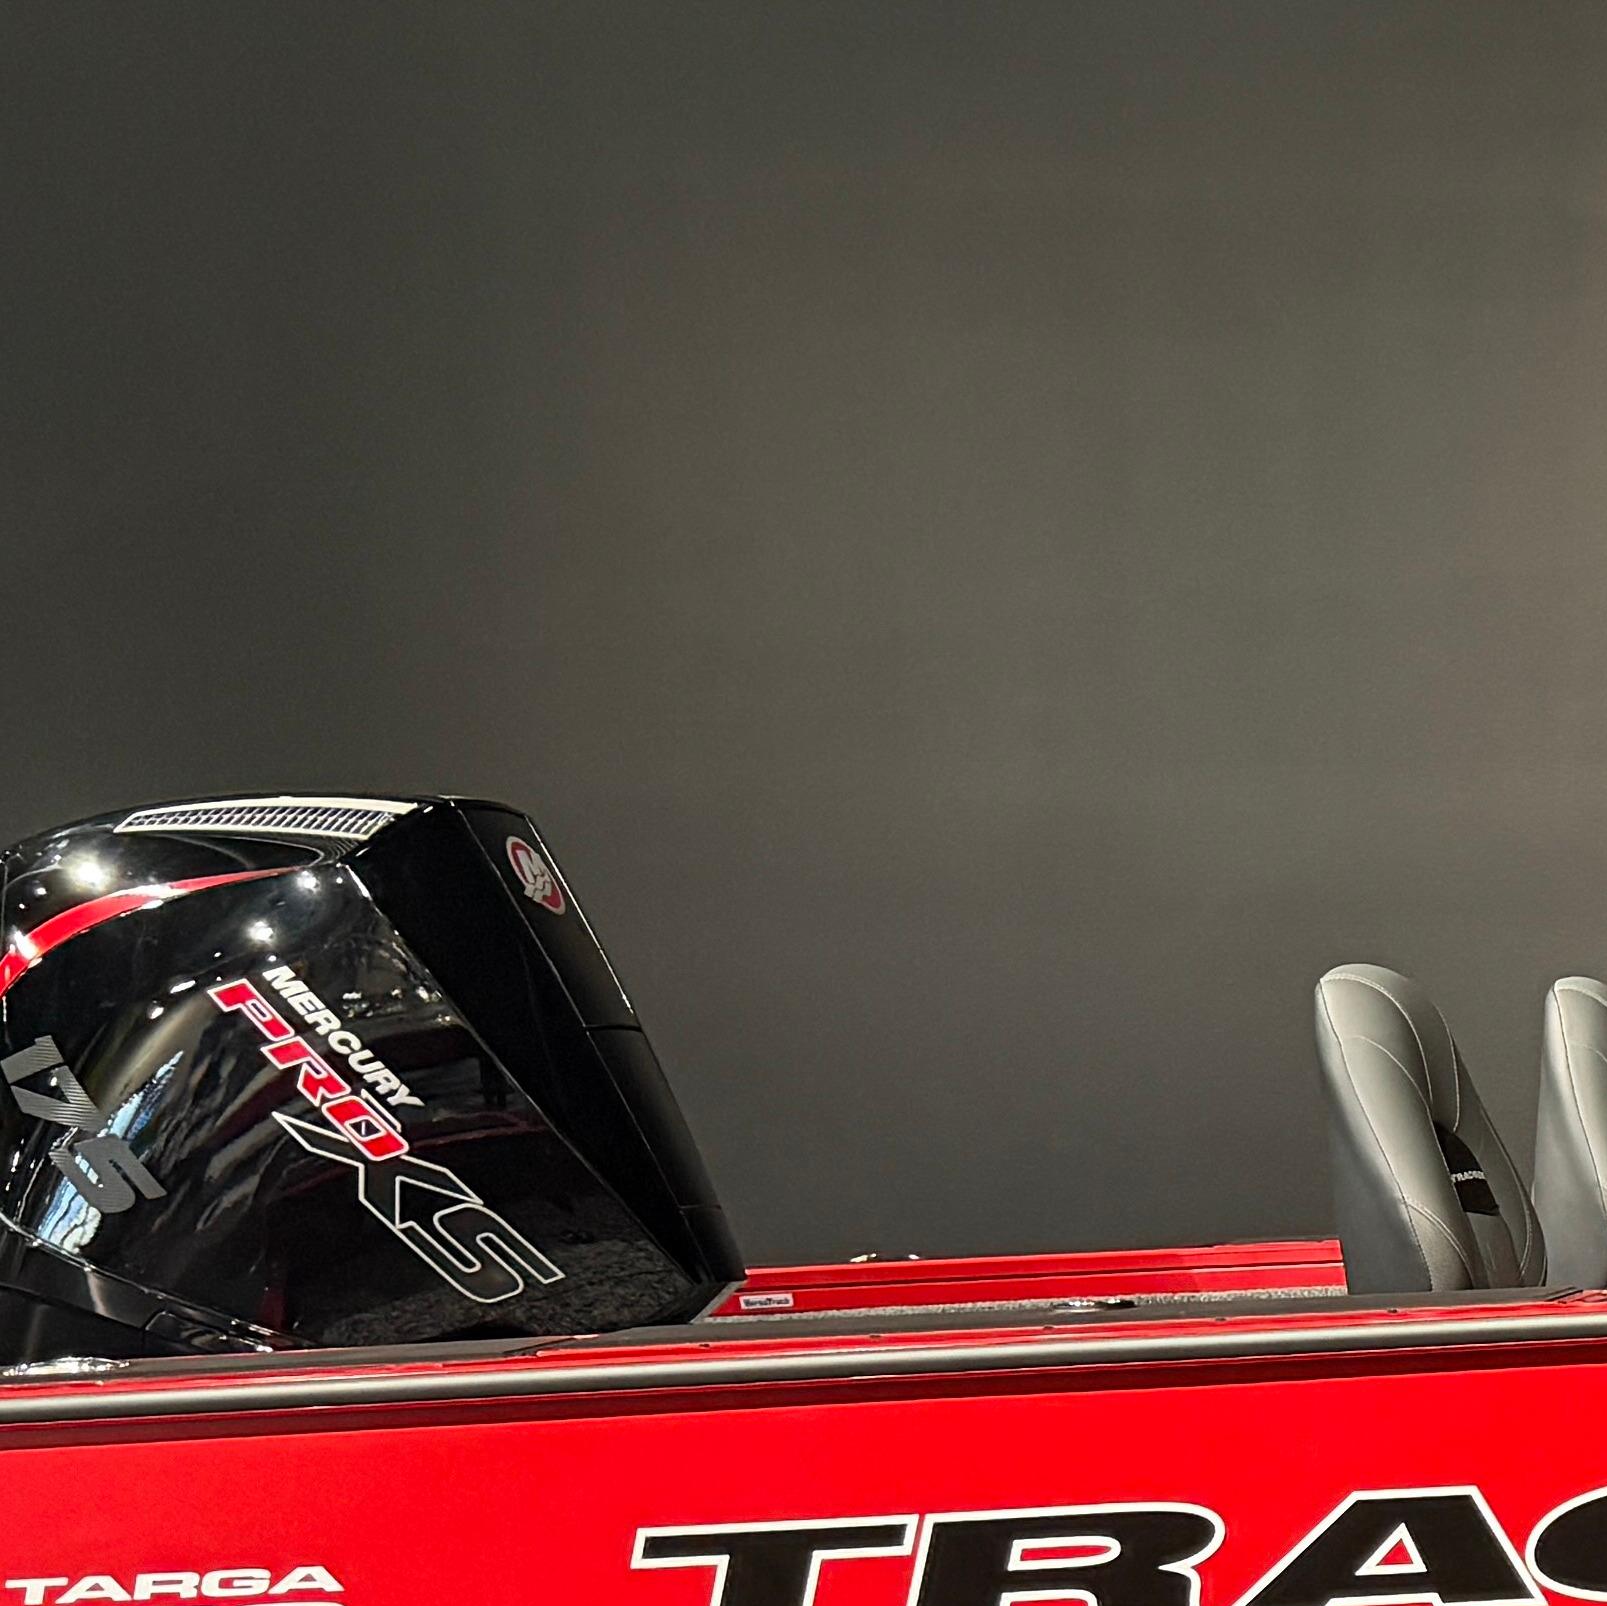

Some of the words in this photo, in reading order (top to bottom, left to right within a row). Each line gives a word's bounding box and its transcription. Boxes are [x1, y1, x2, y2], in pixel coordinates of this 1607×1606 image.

[207, 978, 409, 1162] PRO
[262, 964, 425, 1108] MERCURY
[272, 1110, 566, 1304] XS
[5, 1565, 345, 1606] TARGA
